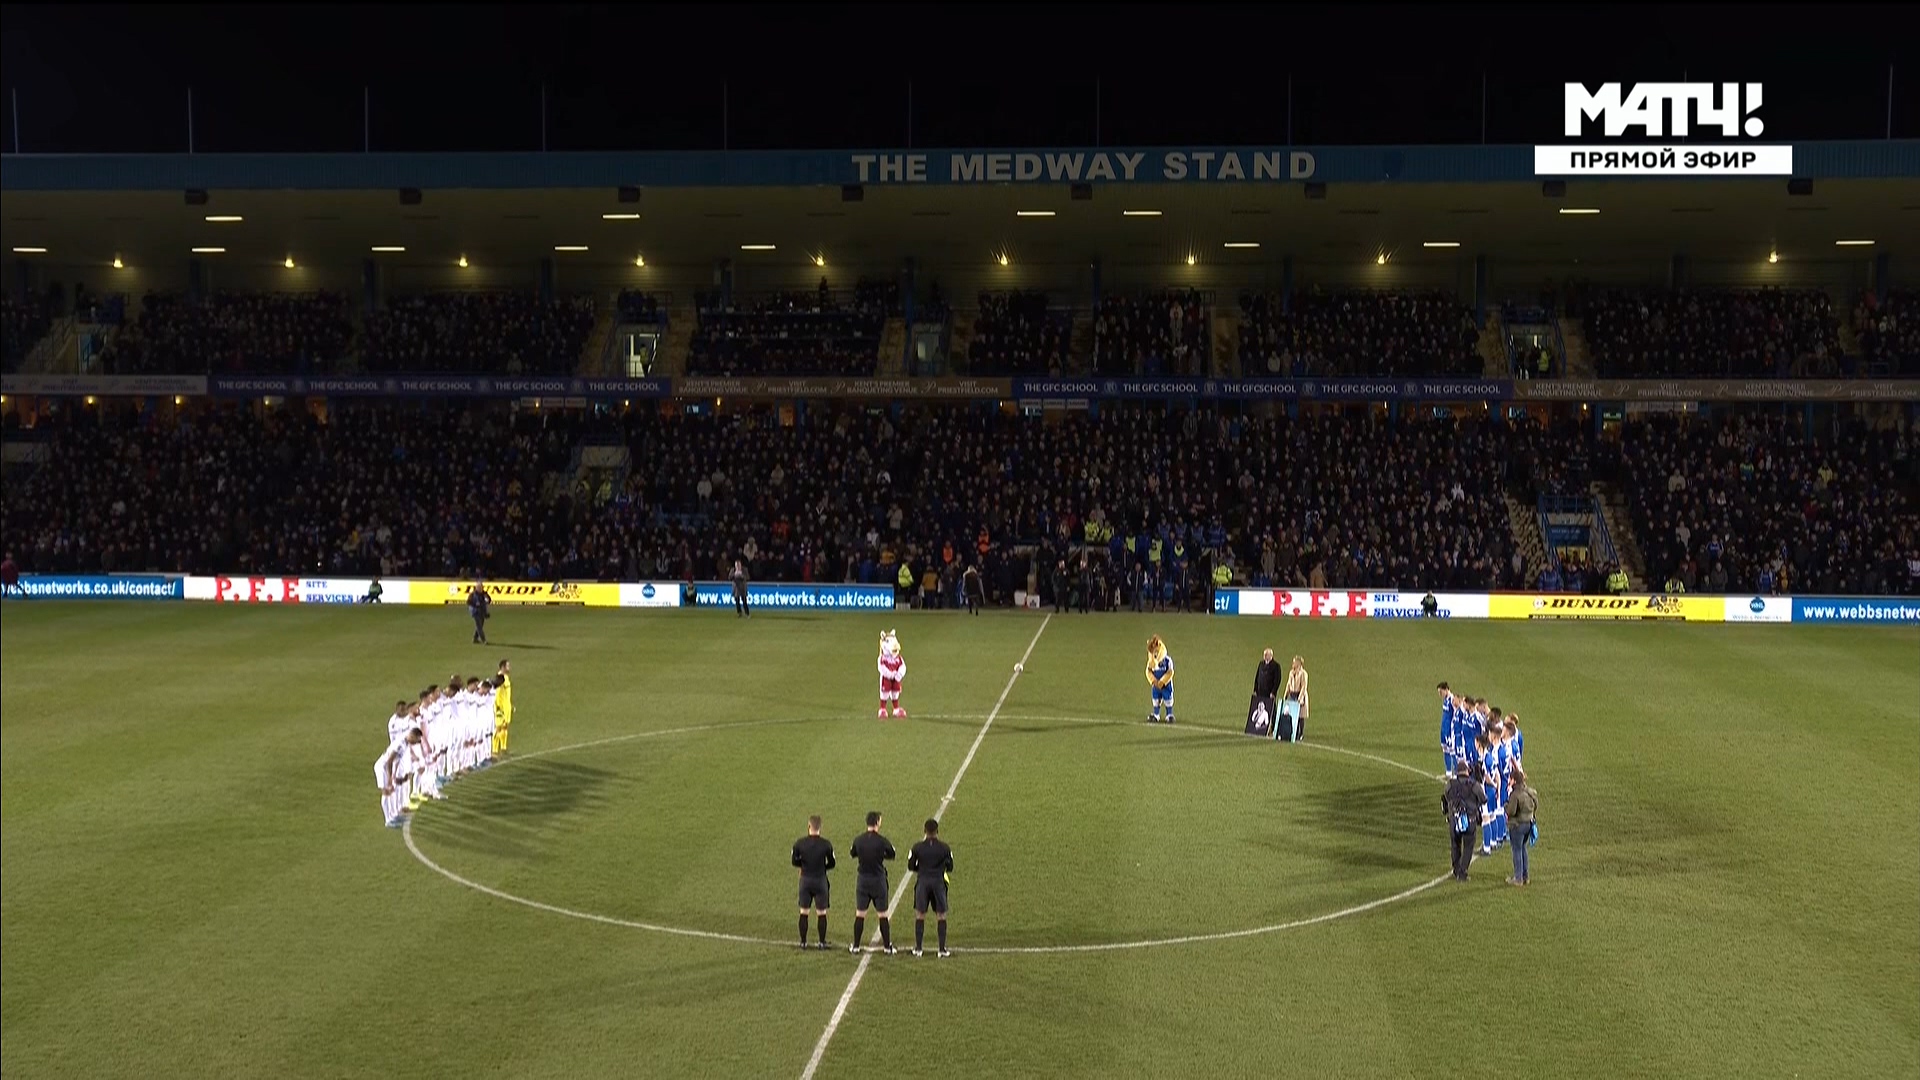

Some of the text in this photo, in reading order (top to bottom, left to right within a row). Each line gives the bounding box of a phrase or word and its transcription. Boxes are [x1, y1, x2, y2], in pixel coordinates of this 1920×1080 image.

[851, 151, 1316, 183] THE MEDWAY STAND
[218, 381, 233, 390] THE
[253, 381, 287, 390] SCHOOL
[310, 381, 326, 391] THE
[344, 381, 378, 391] SCHOOL
[402, 381, 418, 391] THE
[437, 381, 472, 391] SCHOOL
[496, 381, 512, 391] THE
[530, 381, 565, 391] SCHOOL
[590, 382, 605, 391] THE
[624, 382, 659, 391] SCHOOL
[1024, 383, 1098, 392] THE GFC SCHOOL
[1123, 383, 1198, 392] THE GFC SCHOOL
[1223, 384, 1296, 393] THE GFC SCHOOL
[1322, 384, 1398, 394] THE GFC SCHOOL
[1424, 385, 1500, 394] THE GFC SCHOOL
[306, 580, 328, 588] SITE
[306, 594, 354, 603] SERVICES
[1374, 594, 1399, 602] SITE
[1551, 599, 1639, 609] DUNLOP
